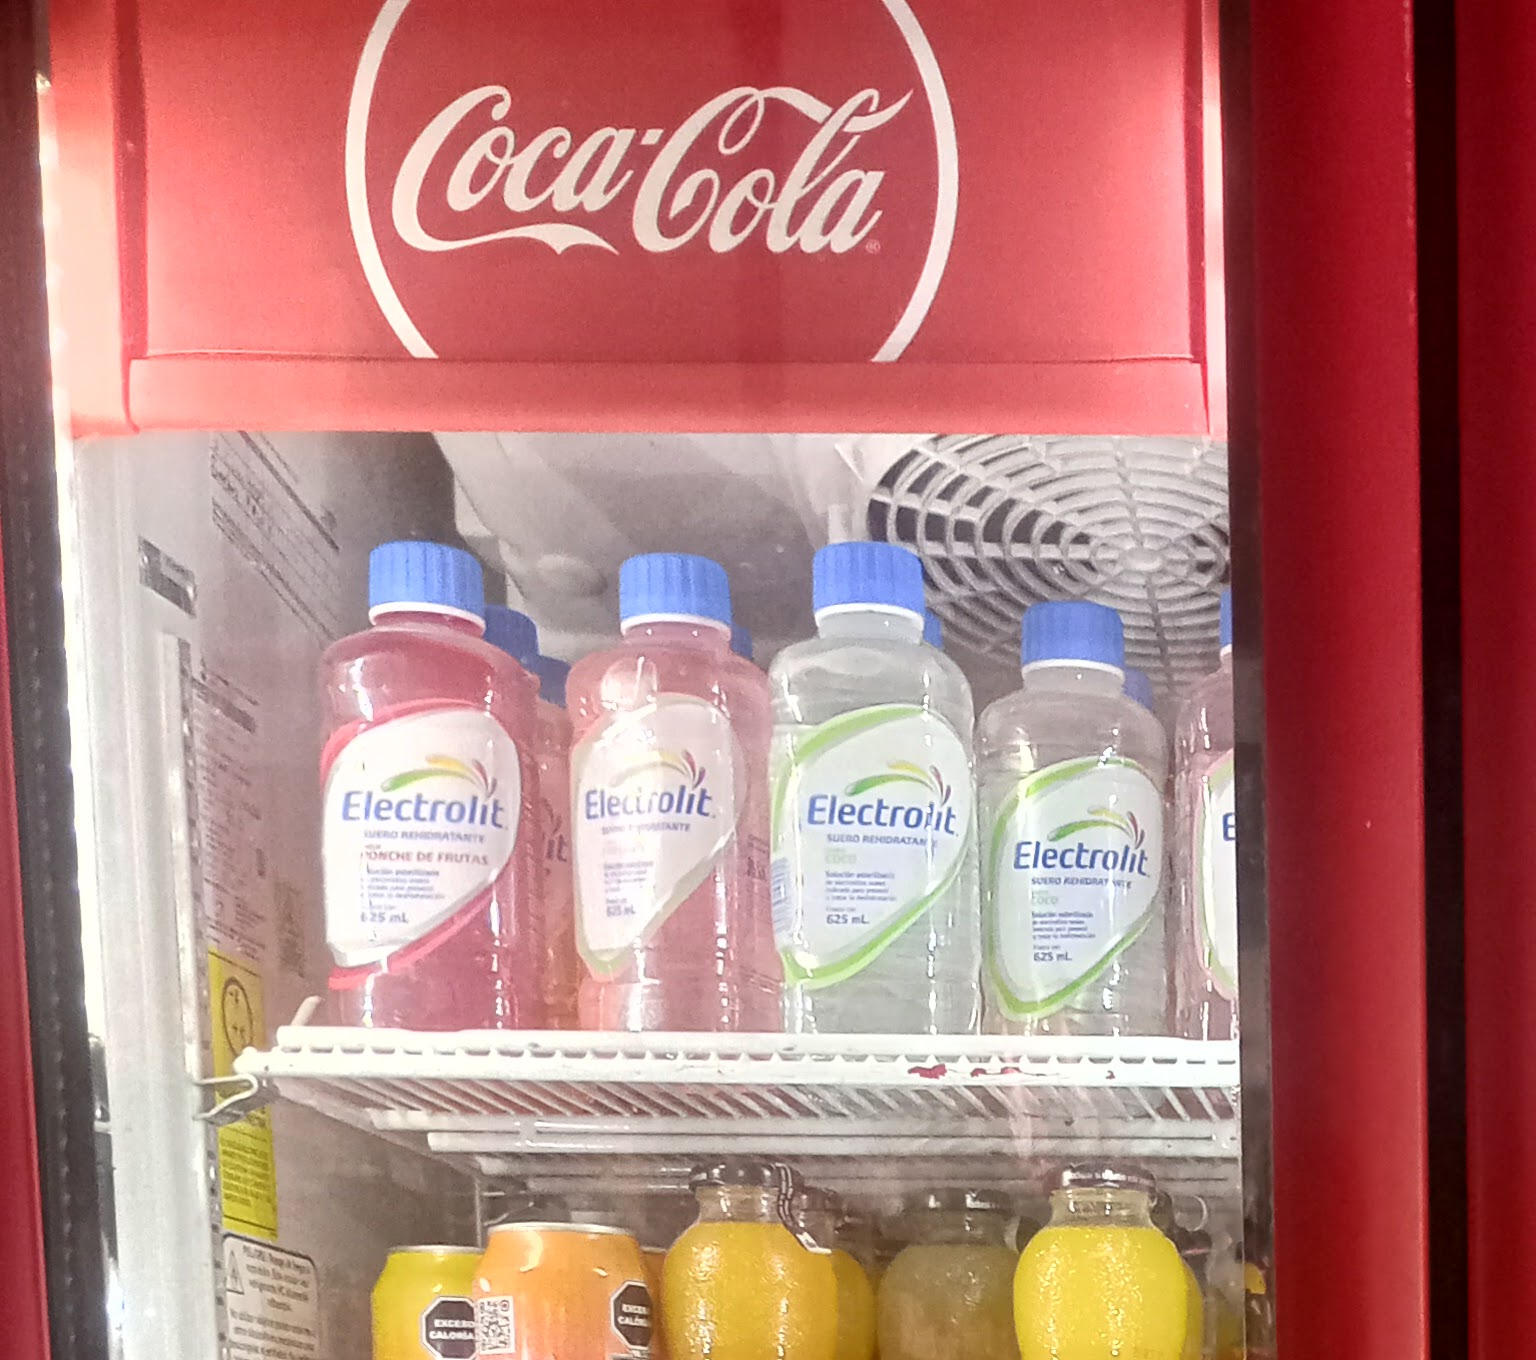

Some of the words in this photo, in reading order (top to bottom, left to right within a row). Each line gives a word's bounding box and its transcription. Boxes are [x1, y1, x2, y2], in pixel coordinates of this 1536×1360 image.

[392, 85, 912, 254] Coca-Cola
[342, 790, 504, 829] Electrolit
[585, 785, 713, 820] Electrolit
[807, 794, 957, 835] Electrolit
[827, 833, 860, 844] SUERO
[862, 835, 938, 848] REHIDRATANE
[417, 851, 434, 863] DE
[437, 852, 489, 866] FRUTAS
[1013, 840, 1148, 876] Electrolit
[826, 914, 848, 924] 625
[1033, 951, 1054, 962] 625
[429, 1330, 474, 1340] CALORÍA
